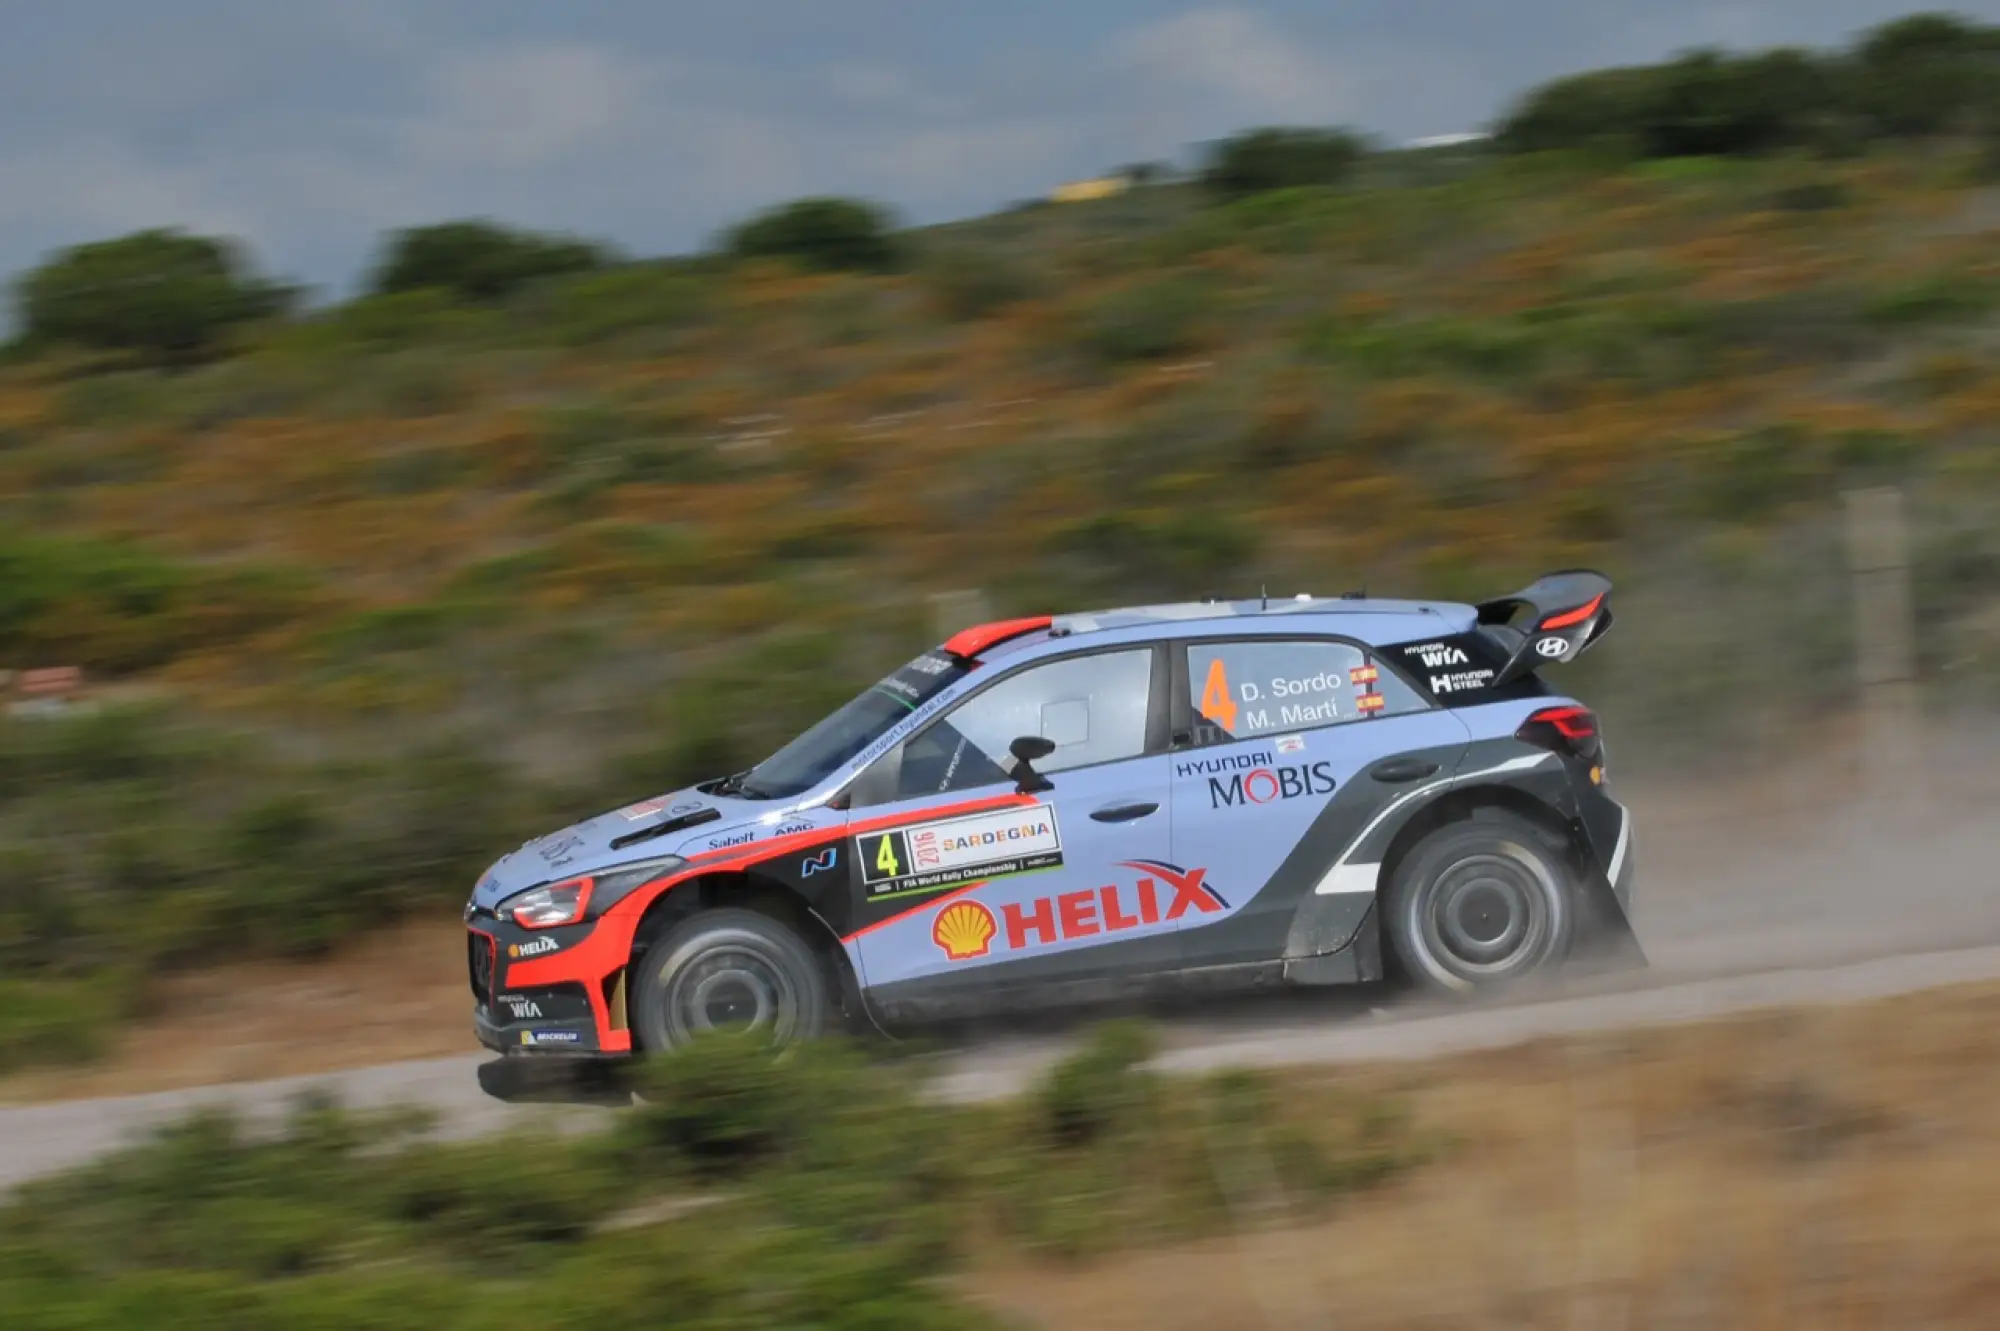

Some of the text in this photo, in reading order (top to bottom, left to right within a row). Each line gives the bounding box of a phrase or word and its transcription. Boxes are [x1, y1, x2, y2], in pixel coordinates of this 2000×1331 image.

[1202, 658, 1237, 732] 4
[1240, 672, 1342, 703] D. Sordo
[1453, 678, 1485, 691] STEEL
[1246, 708, 1275, 731] M.
[1177, 751, 1273, 778] HYUNDAI
[1208, 761, 1337, 810] MOBIS
[708, 831, 755, 849] Sabelt
[943, 822, 1049, 852] SARDEGNA
[876, 832, 899, 877] 4
[919, 875, 941, 887] World
[942, 870, 962, 882] Rally
[963, 862, 1017, 878] Championship
[1000, 860, 1223, 949] HELIX
[519, 936, 560, 957] HELIX
